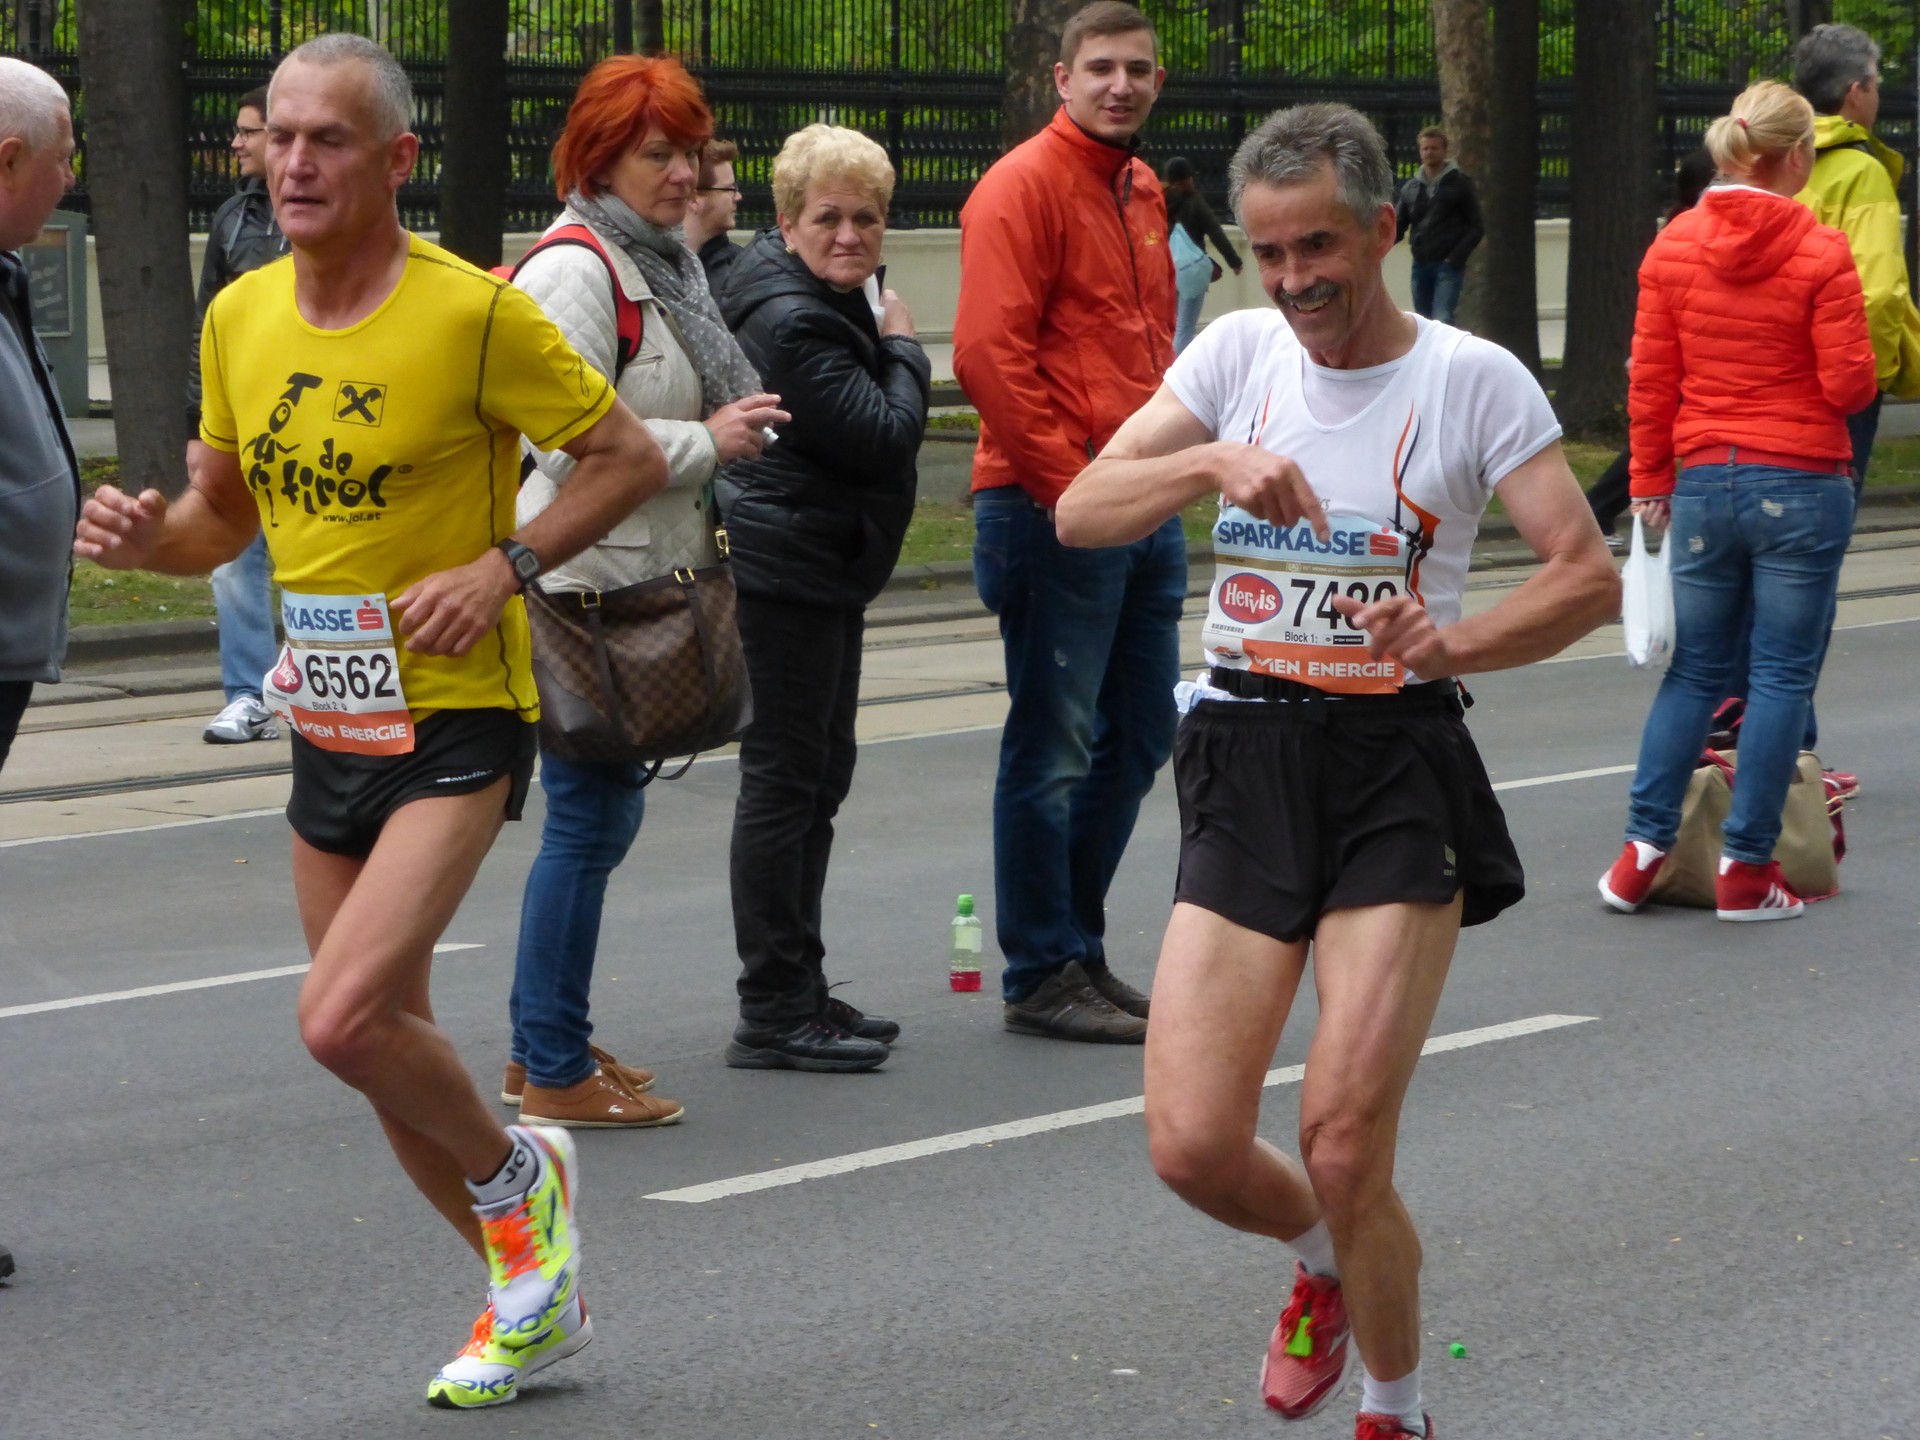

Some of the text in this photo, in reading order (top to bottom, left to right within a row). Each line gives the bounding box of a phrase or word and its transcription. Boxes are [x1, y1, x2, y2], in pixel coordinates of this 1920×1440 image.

[322, 511, 382, 523] www.jol.at
[1224, 581, 1277, 614] Hervis
[1284, 631, 1309, 643] Block
[305, 653, 397, 700] 6562
[1253, 655, 1395, 678] WIEN ENERGIE
[312, 700, 338, 711] Block 2
[300, 721, 408, 742] WIEN ENERGIE
